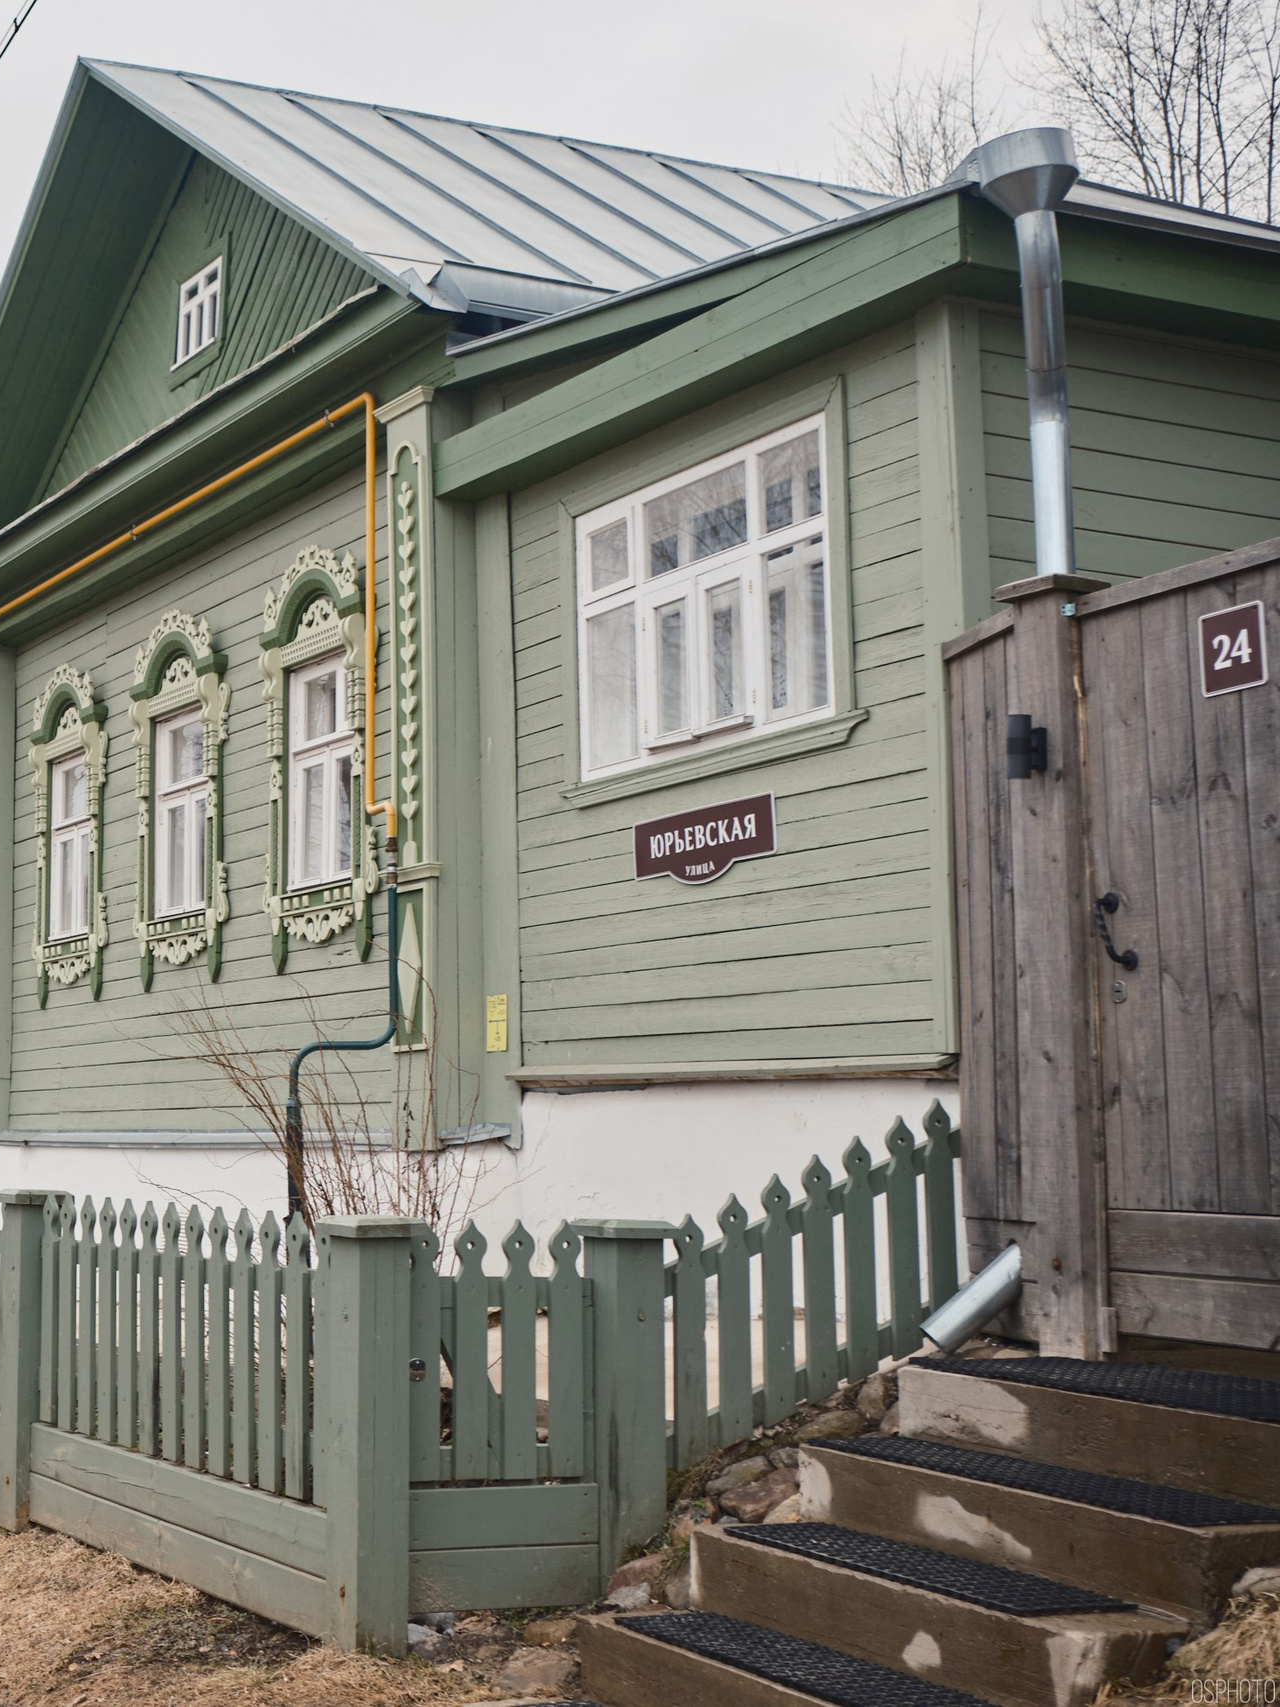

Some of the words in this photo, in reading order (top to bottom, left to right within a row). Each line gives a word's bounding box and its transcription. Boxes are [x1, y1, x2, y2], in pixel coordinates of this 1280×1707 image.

[1212, 628, 1252, 671] 24
[649, 813, 757, 860] ЮРЬЕВСКАЯ
[685, 861, 715, 877] УЛИЦА
